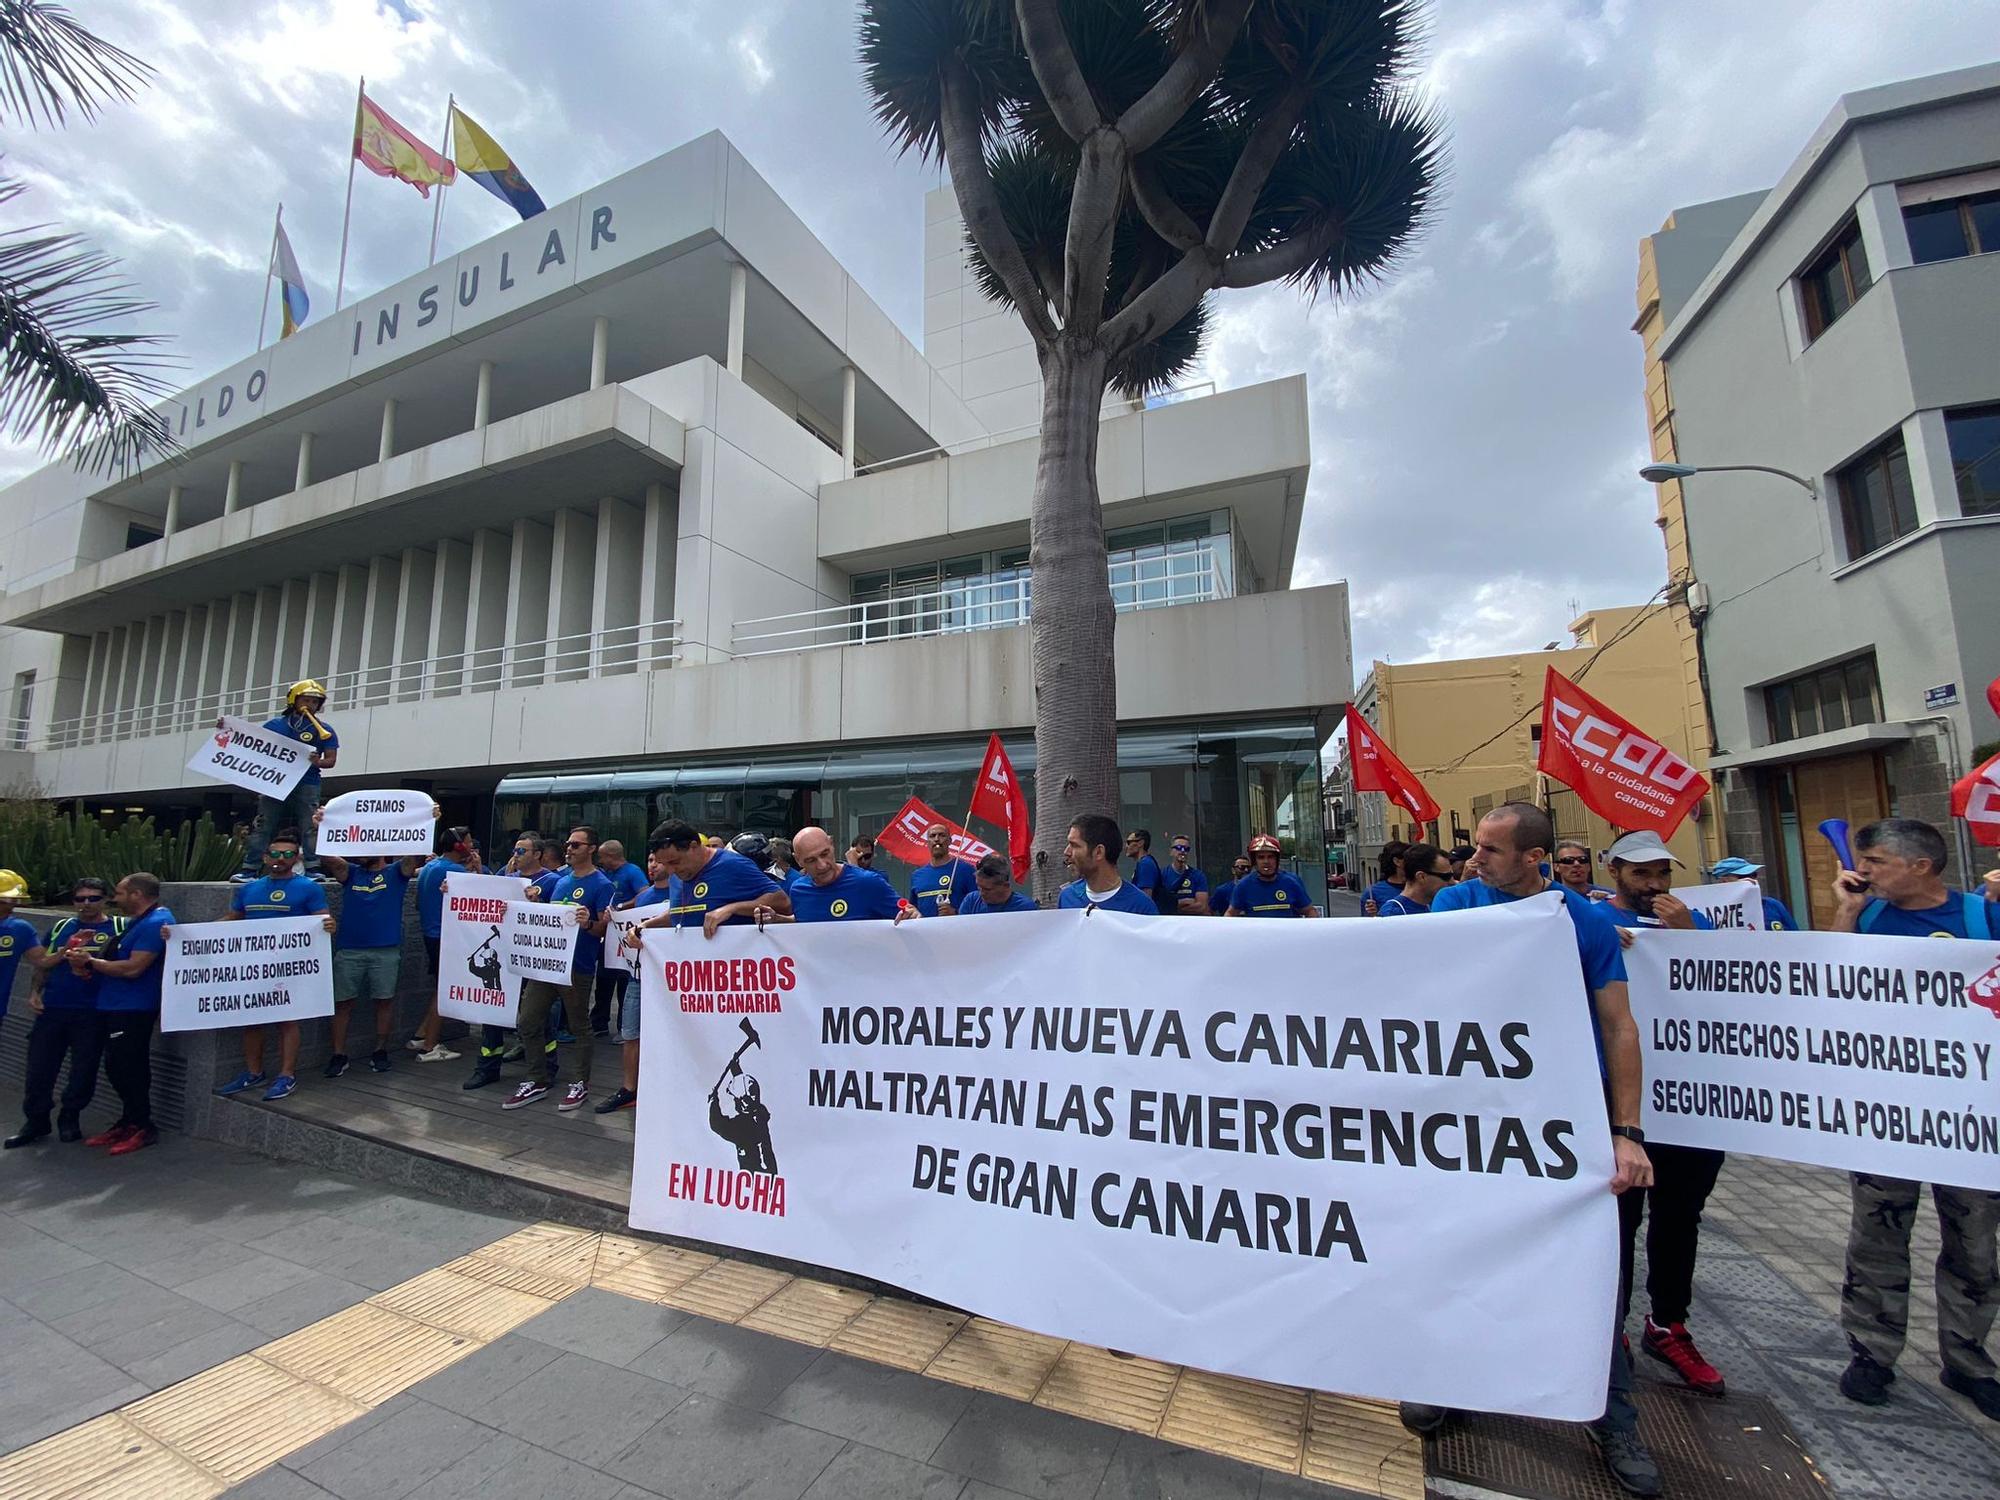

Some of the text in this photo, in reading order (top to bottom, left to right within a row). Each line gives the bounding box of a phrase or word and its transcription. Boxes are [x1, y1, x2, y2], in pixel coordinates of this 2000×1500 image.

[353, 205, 617, 356] INSULAR
[230, 730, 298, 764] MORALES
[211, 751, 286, 786] SOLUCIÓN
[1581, 759, 1676, 806] a la ciudadanía
[355, 799, 406, 814] ESTAMOS
[1614, 790, 1667, 819] canarias
[450, 896, 504, 914] BOMBER
[457, 912, 479, 922] GRAN
[182, 932, 311, 956] EXIGIMOS UN TRATO JUSTO
[513, 933, 568, 951] CUIDA LA SALUD
[174, 958, 320, 985] Y DIGNO PARA LOS BOMBEROS
[511, 953, 568, 974] DE TUS BOMBEROS
[665, 956, 796, 992] BOMBEROS
[449, 985, 506, 1008] EN LUCHA
[1669, 958, 1968, 1009] BOMBEROS EN LUCHA POR
[199, 989, 291, 1013] DE GRAN CANARIA
[680, 992, 782, 1014] GRAN CANARIA
[821, 1006, 1535, 1080] MORALES Y NUEVA CANARIAS
[1653, 1017, 1992, 1082] LOS DRECHOS LABORABLES Y
[808, 1068, 1579, 1181] MALTRATAN LAS EMERGENCIAS
[1652, 1078, 2000, 1155] SEGURIDAD DE LA POBLACIÓN
[668, 1162, 787, 1219] EN LUCHA
[912, 1144, 1368, 1264] DE GRAN CANARIA
